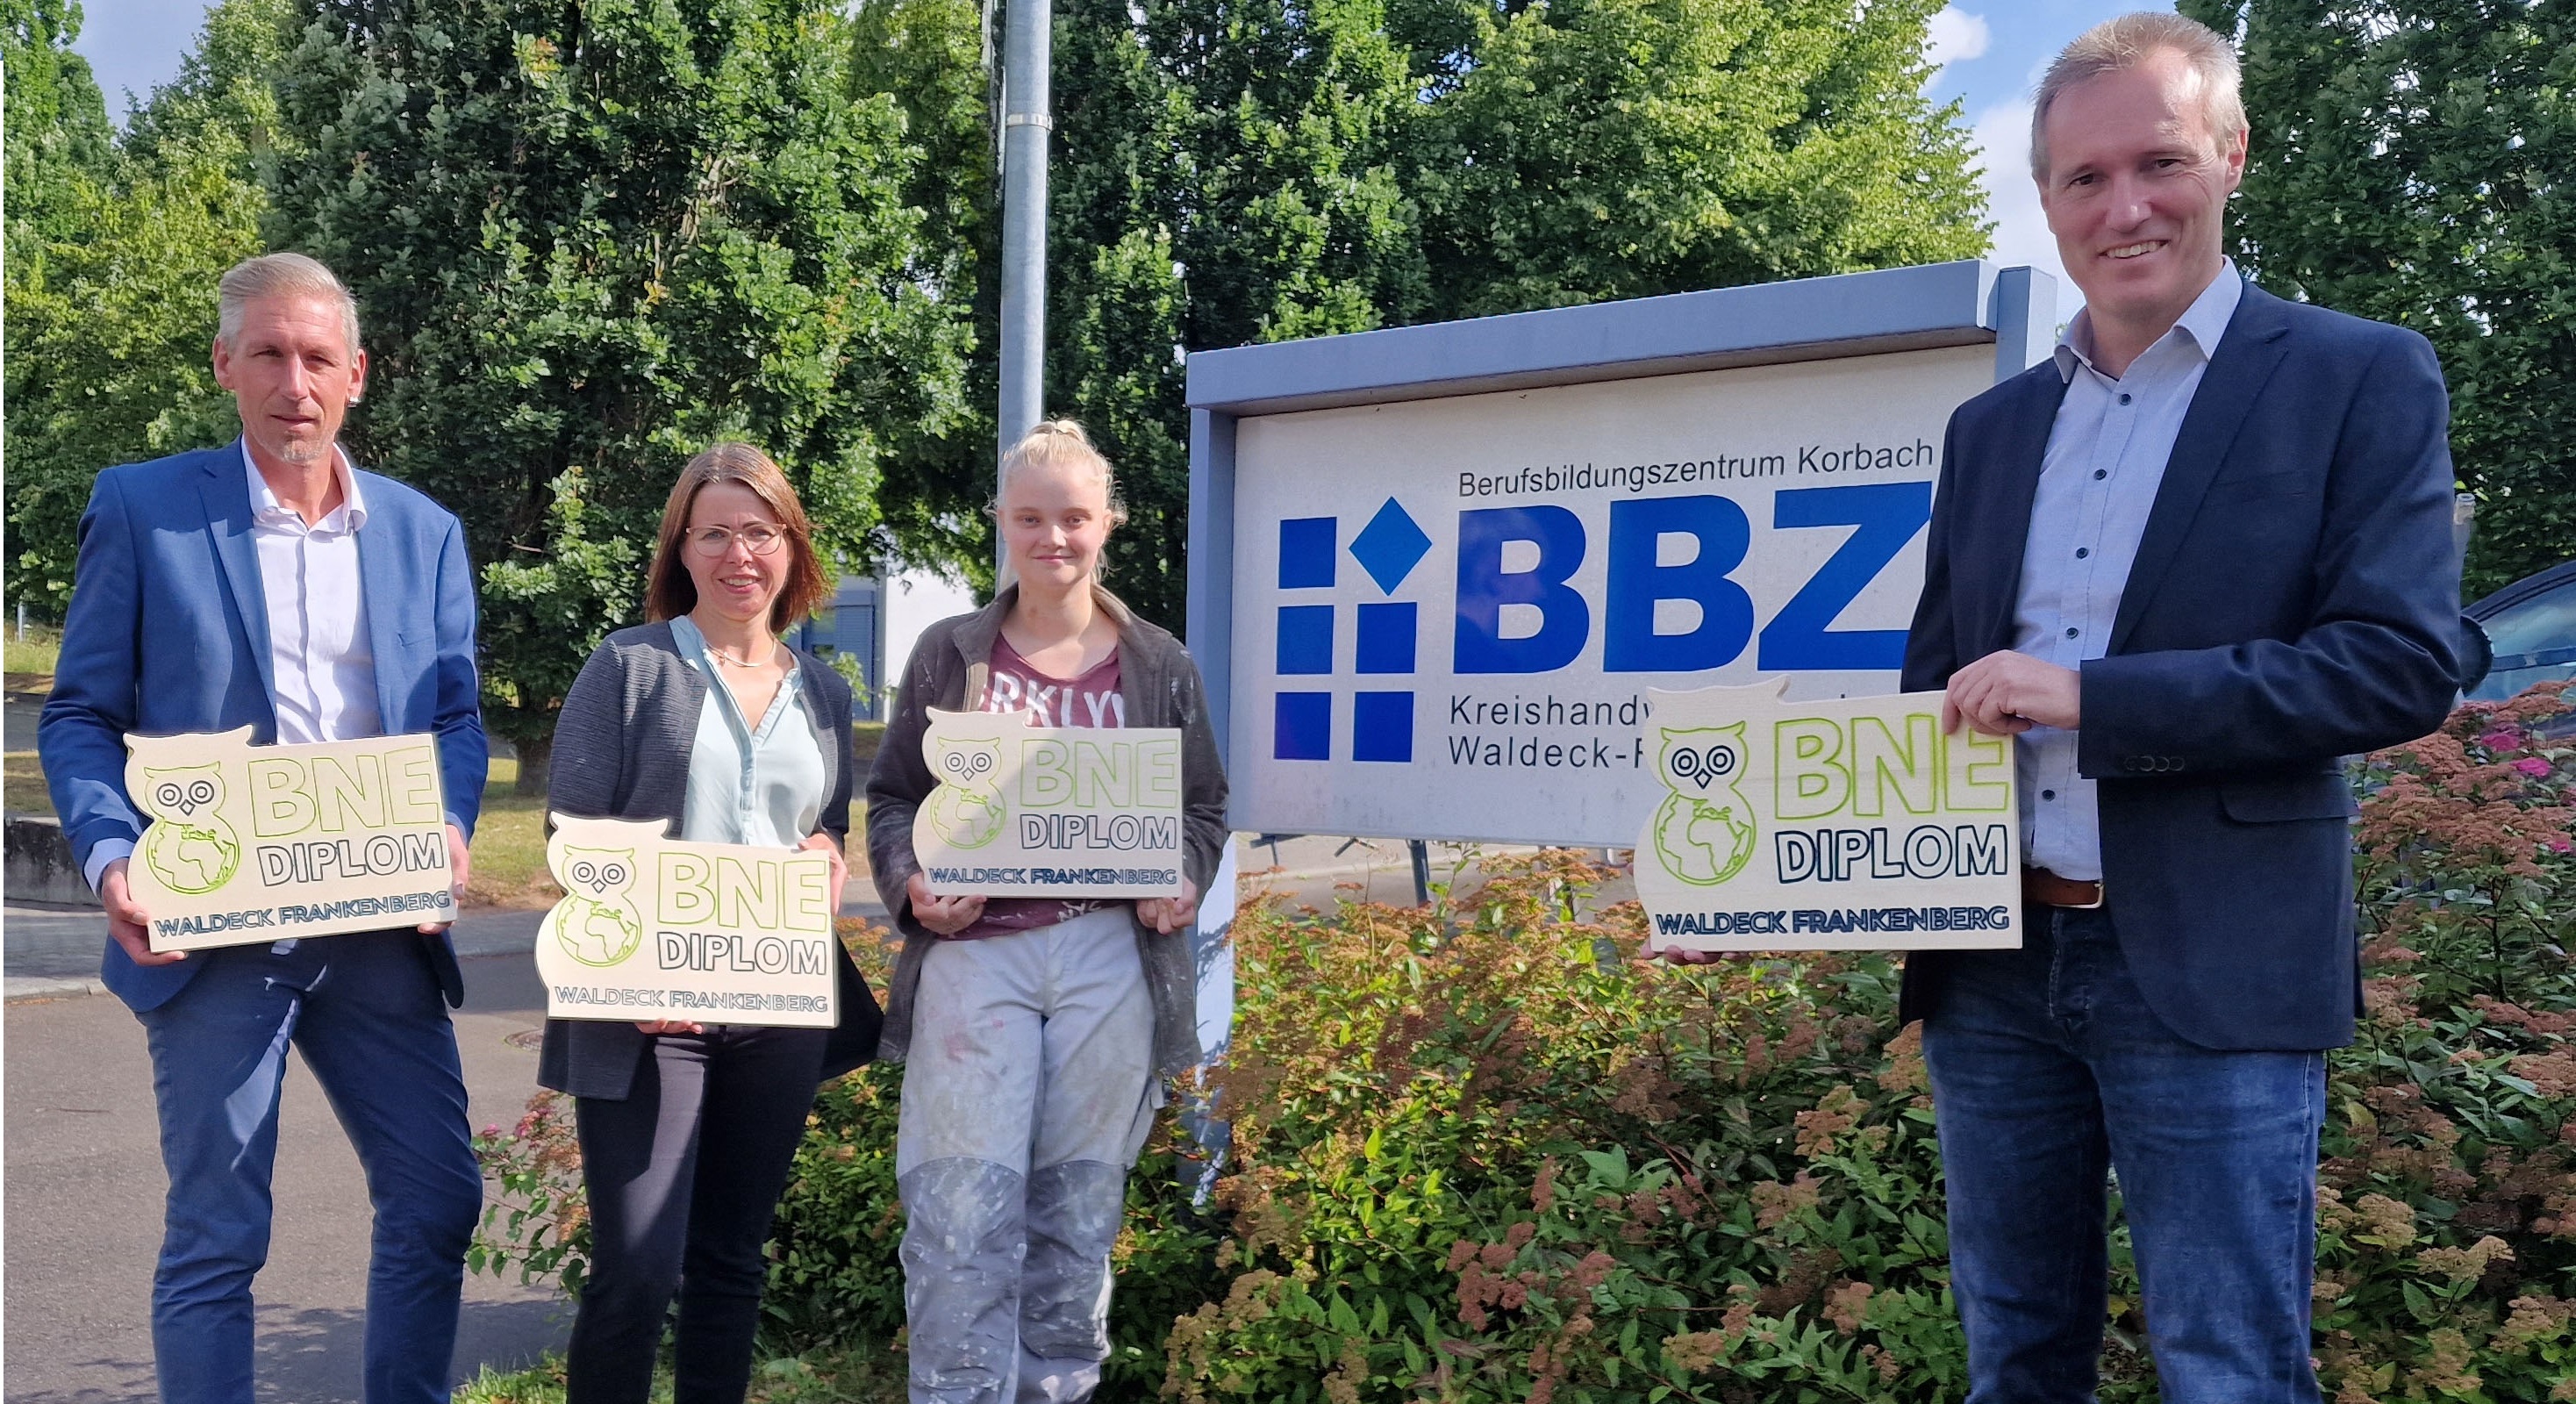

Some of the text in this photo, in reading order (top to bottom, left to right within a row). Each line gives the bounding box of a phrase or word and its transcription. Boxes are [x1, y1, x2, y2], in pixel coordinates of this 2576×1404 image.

[1458, 439, 1933, 498] Berufsbildungszentrum Korbach
[1453, 481, 1932, 674] BBZ
[1450, 695, 1649, 725] Kreishand
[247, 745, 440, 838] BNE
[1020, 739, 1178, 808] BNE
[1774, 713, 2009, 820] BNE
[1020, 813, 1177, 849] DIPLOM
[1774, 824, 2008, 885] DIPLOM
[256, 832, 445, 887] DIPLOM
[928, 867, 1177, 885] WALDECK FRANKENBERG
[153, 891, 452, 938] WALDECK FRANKENBERG
[656, 852, 827, 933] BNE
[1655, 905, 2010, 935] WALDECK FRANKENBERG
[656, 931, 827, 976] DIPLOM
[555, 985, 828, 1013] WALDECK FRANKENBERG
